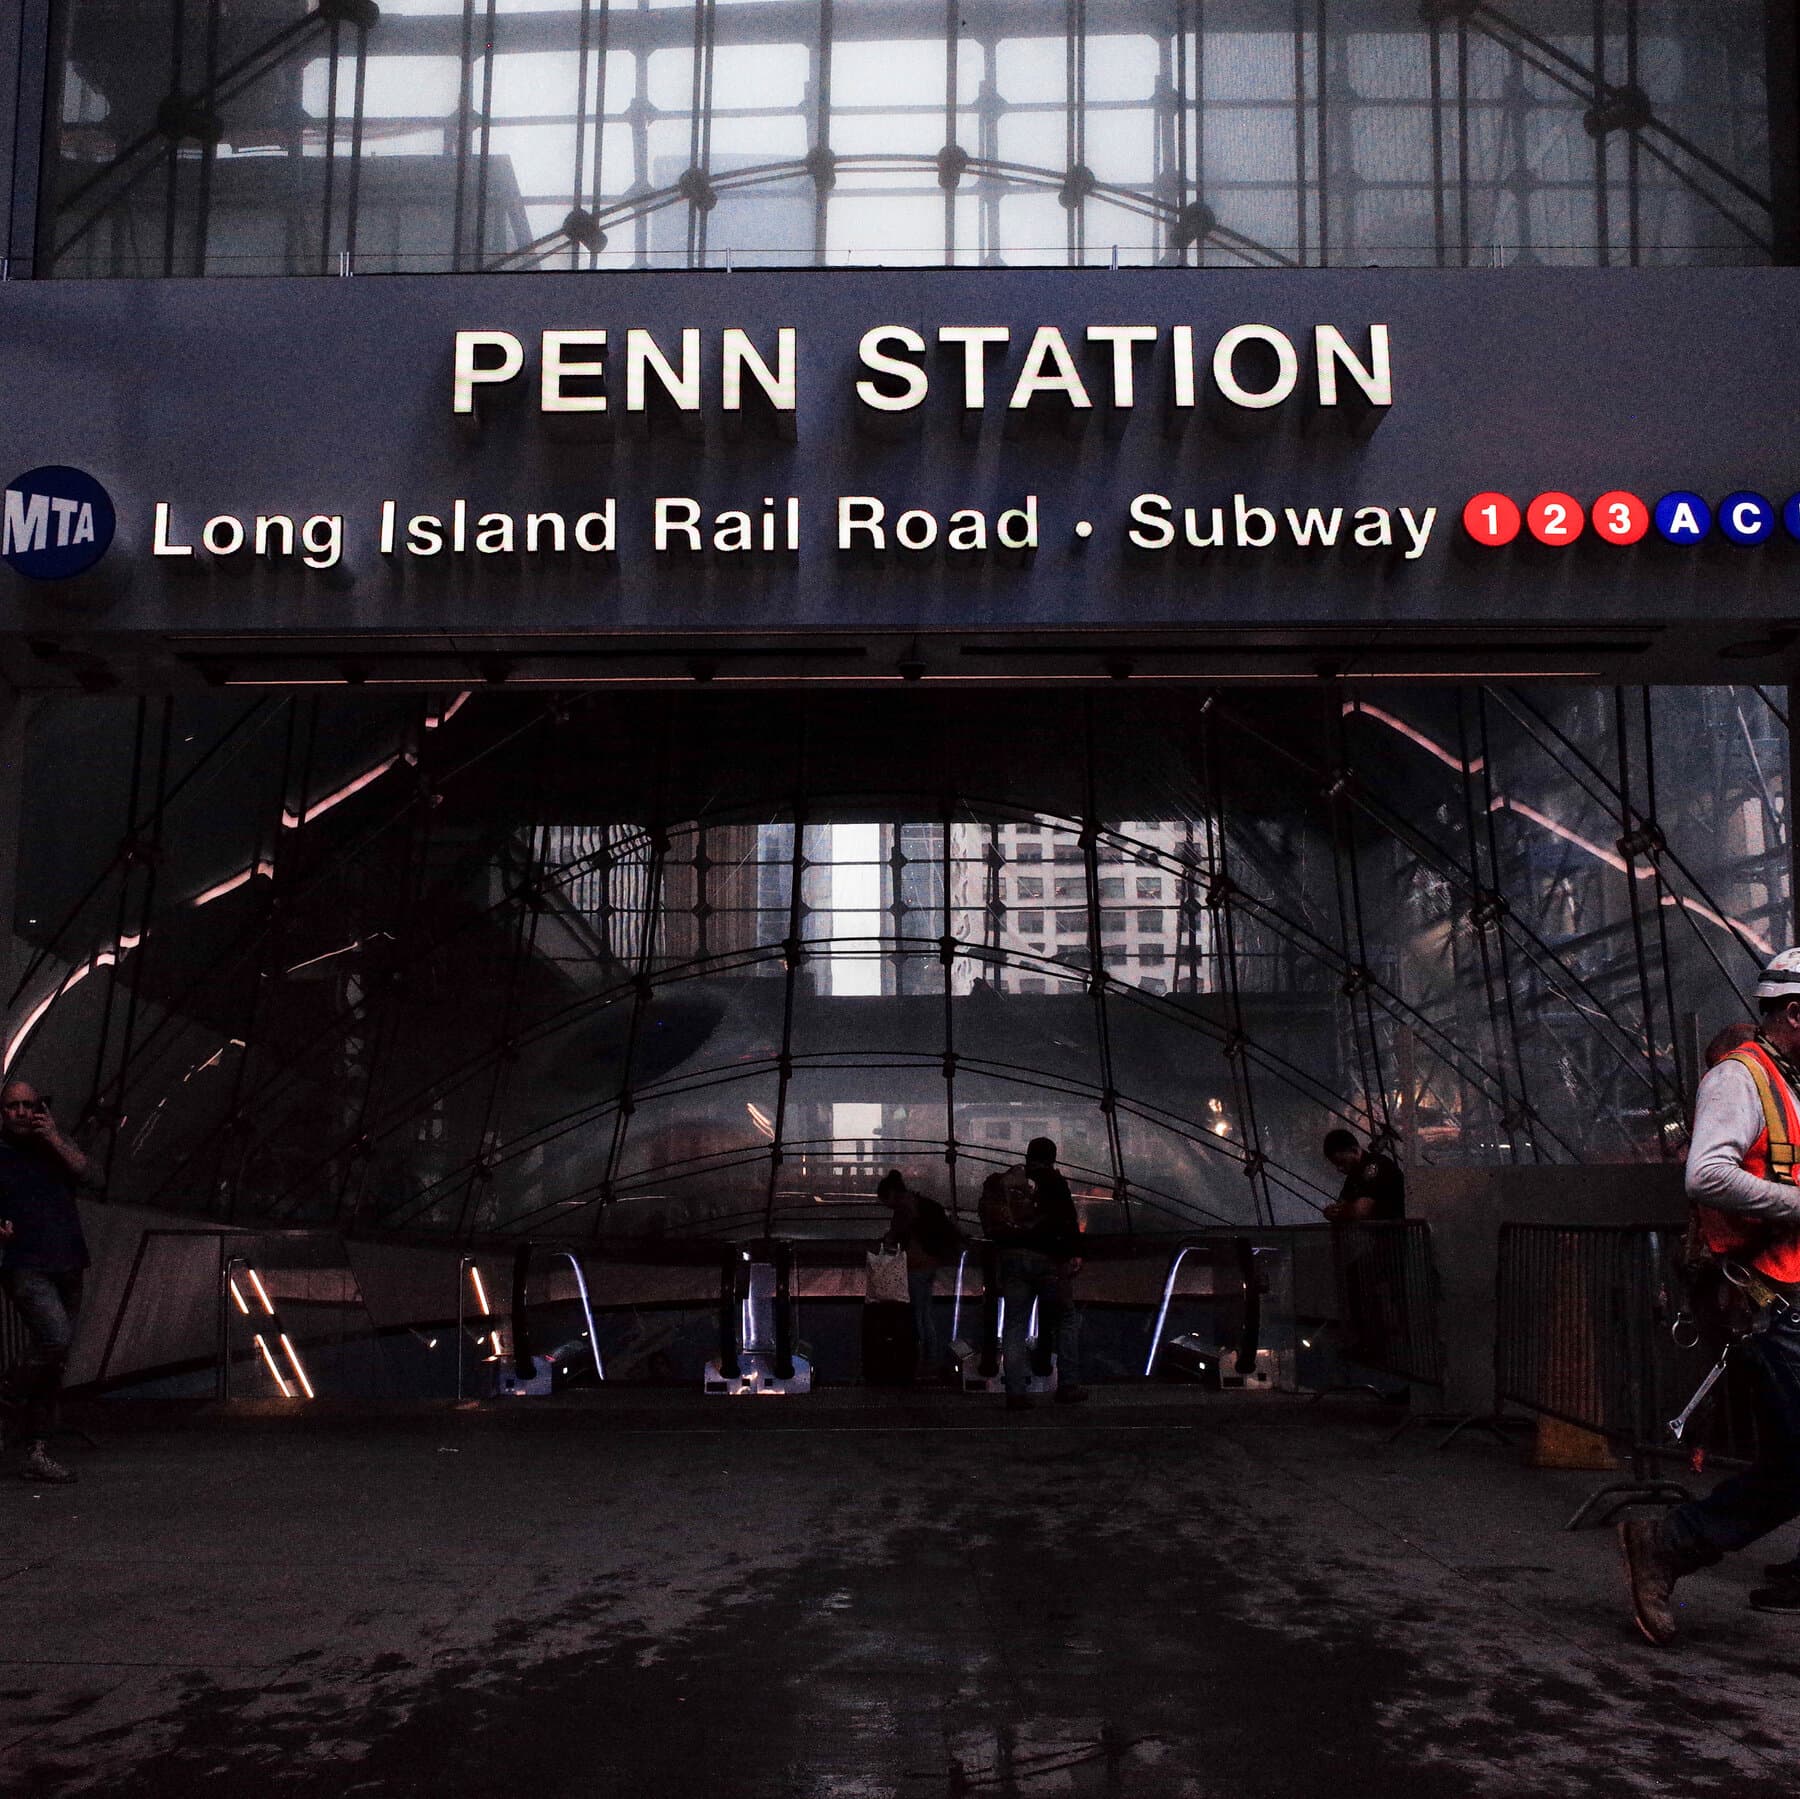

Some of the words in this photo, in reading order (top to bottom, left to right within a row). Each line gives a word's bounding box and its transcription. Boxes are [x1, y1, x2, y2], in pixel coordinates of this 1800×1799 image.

[454, 328, 796, 412] PENN
[857, 325, 1391, 410] STATION
[2, 489, 95, 555] MTA
[154, 503, 342, 569] Long
[381, 500, 616, 555] Island
[656, 498, 799, 551] Rail
[839, 497, 1038, 549] Road
[1130, 494, 1437, 558] Subway
[1482, 505, 1498, 535] 1
[1543, 504, 1567, 534] 2
[1608, 503, 1632, 534] 3
[1669, 503, 1700, 534] A
[1732, 502, 1761, 535] C
